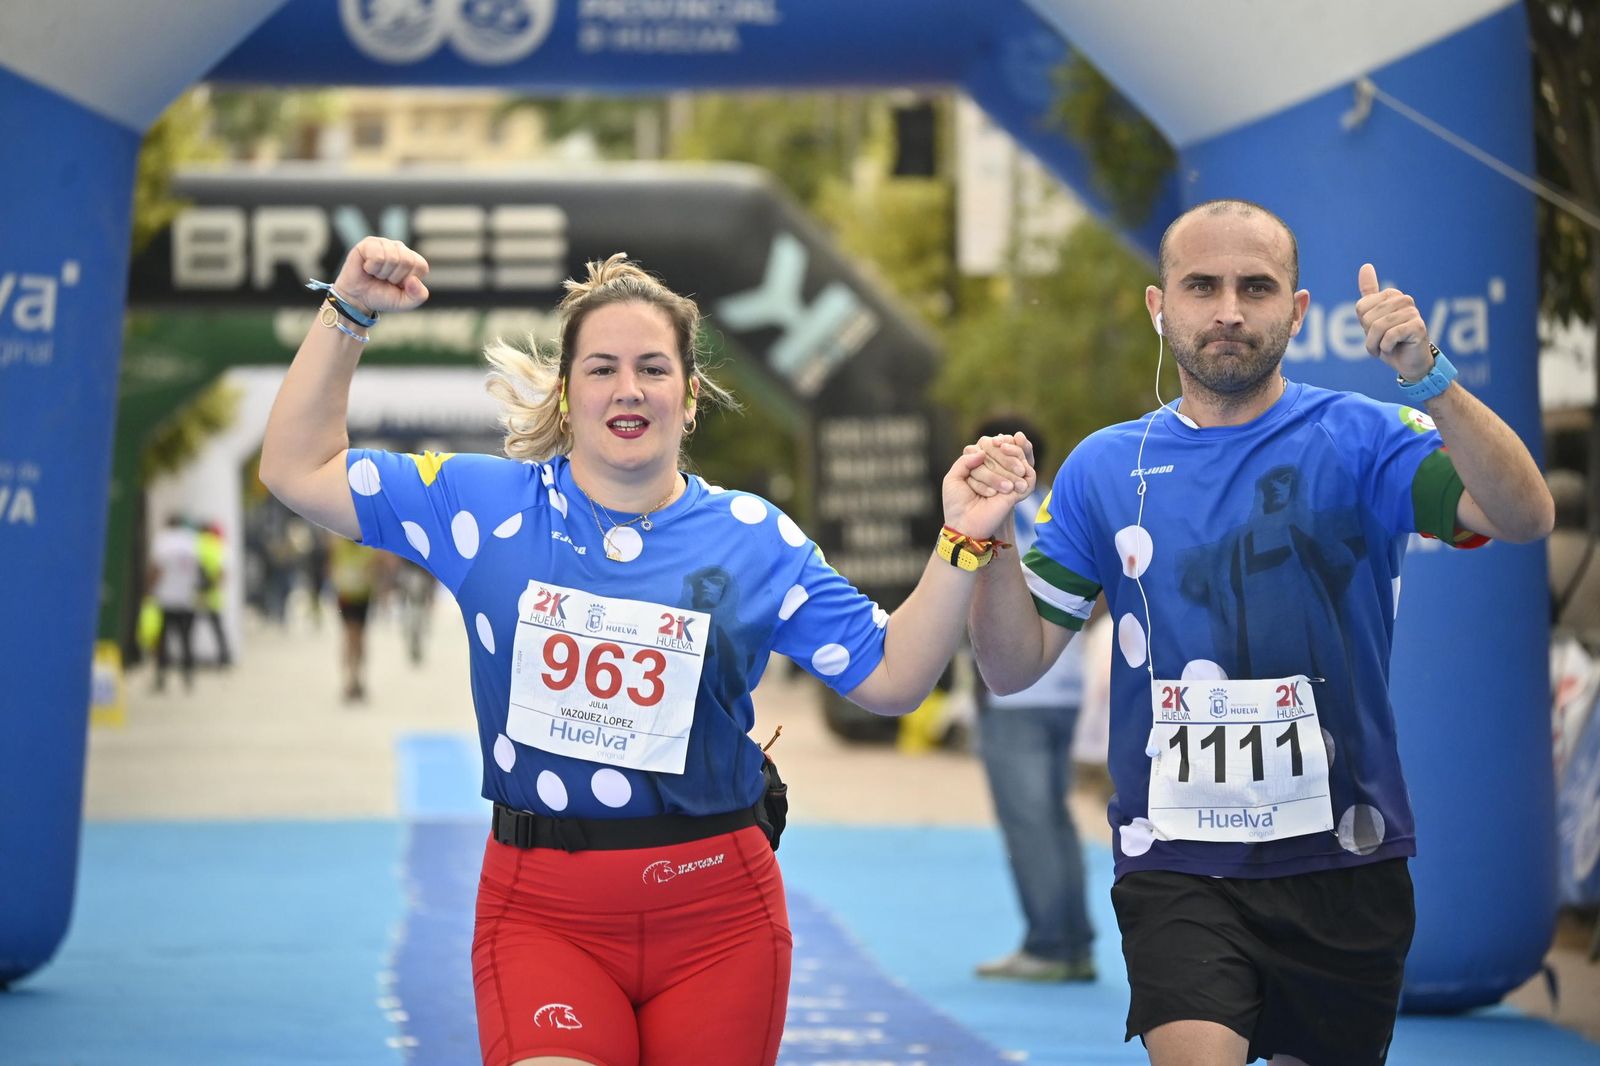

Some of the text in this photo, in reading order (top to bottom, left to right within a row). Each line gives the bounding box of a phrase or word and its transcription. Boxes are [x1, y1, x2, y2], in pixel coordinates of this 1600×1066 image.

[529, 612, 566, 629] HUELVA
[605, 624, 638, 636] HUELVA
[655, 636, 693, 652] HUELVA
[541, 633, 667, 707] 963
[588, 700, 609, 711] JULIA
[1230, 707, 1259, 715] HUELVA
[1276, 706, 1306, 719] HUELVA
[560, 707, 634, 729] VAZQUEZ LOPEZ
[1161, 711, 1191, 721] HUELVA
[549, 718, 628, 752] Huelva
[1169, 721, 1304, 783] 1111
[1198, 809, 1274, 828] Huelva
